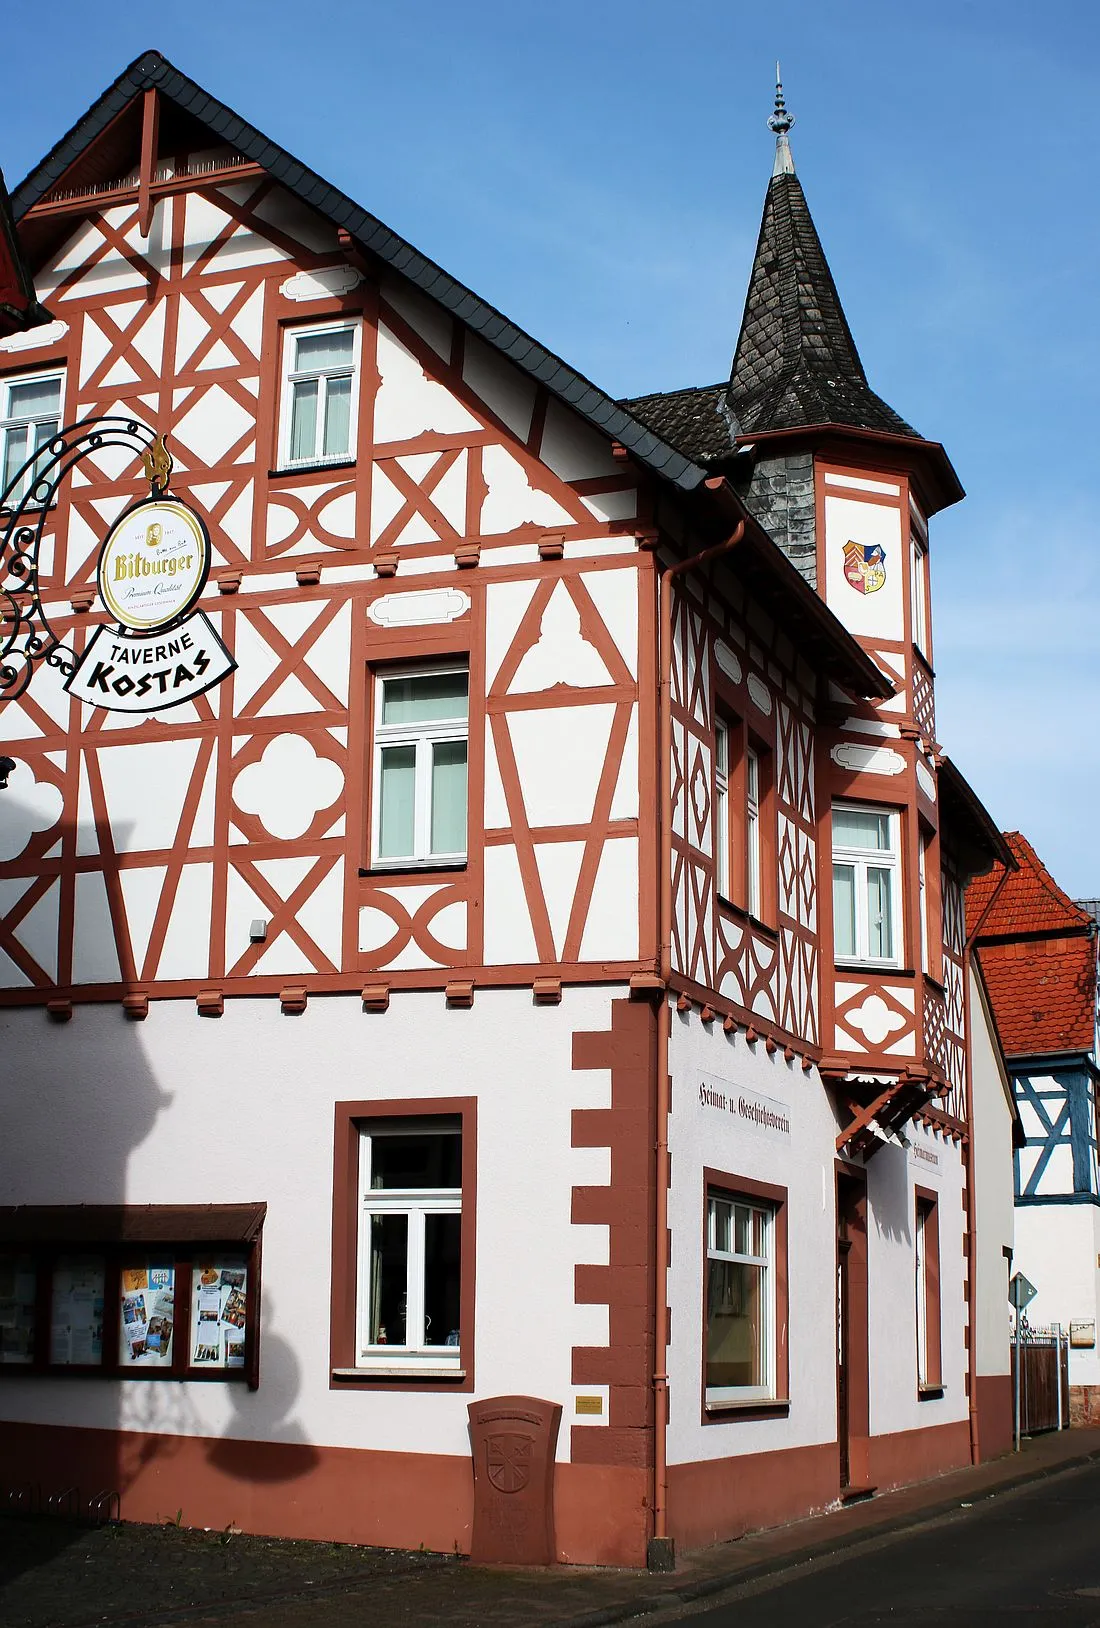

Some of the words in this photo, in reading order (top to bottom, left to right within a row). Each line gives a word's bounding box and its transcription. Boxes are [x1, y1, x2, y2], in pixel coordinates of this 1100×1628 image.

[113, 552, 194, 582] Bitburger
[121, 586, 152, 600] Premium
[110, 632, 195, 665] TAVERNE
[87, 649, 211, 697] KOSTAS
[729, 1098, 736, 1114] u.
